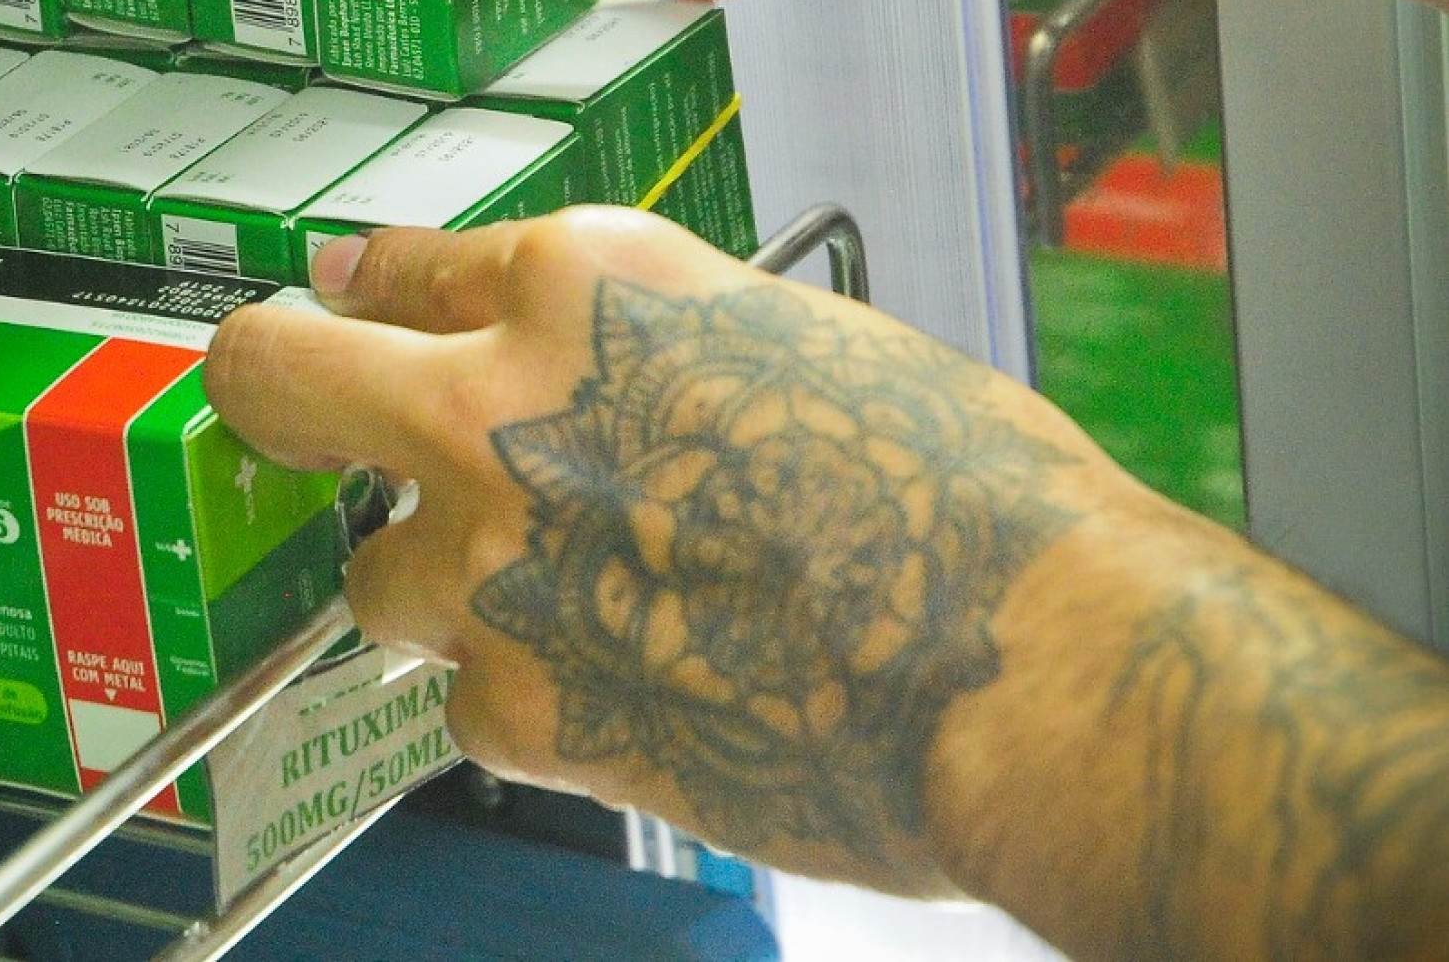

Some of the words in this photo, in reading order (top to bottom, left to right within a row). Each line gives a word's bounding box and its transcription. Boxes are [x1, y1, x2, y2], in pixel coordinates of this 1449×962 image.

[26, 14, 38, 23] 7
[289, 37, 302, 46] 7
[165, 222, 180, 233] 7
[55, 492, 80, 509] USO
[85, 496, 110, 513] SOB
[46, 507, 124, 534] PRESCRIÇÃO
[67, 650, 107, 669] RASPE
[113, 658, 145, 675] AQUI
[72, 667, 99, 684] COM
[104, 672, 147, 692] METAL
[246, 725, 451, 872] 500MG/50ML
